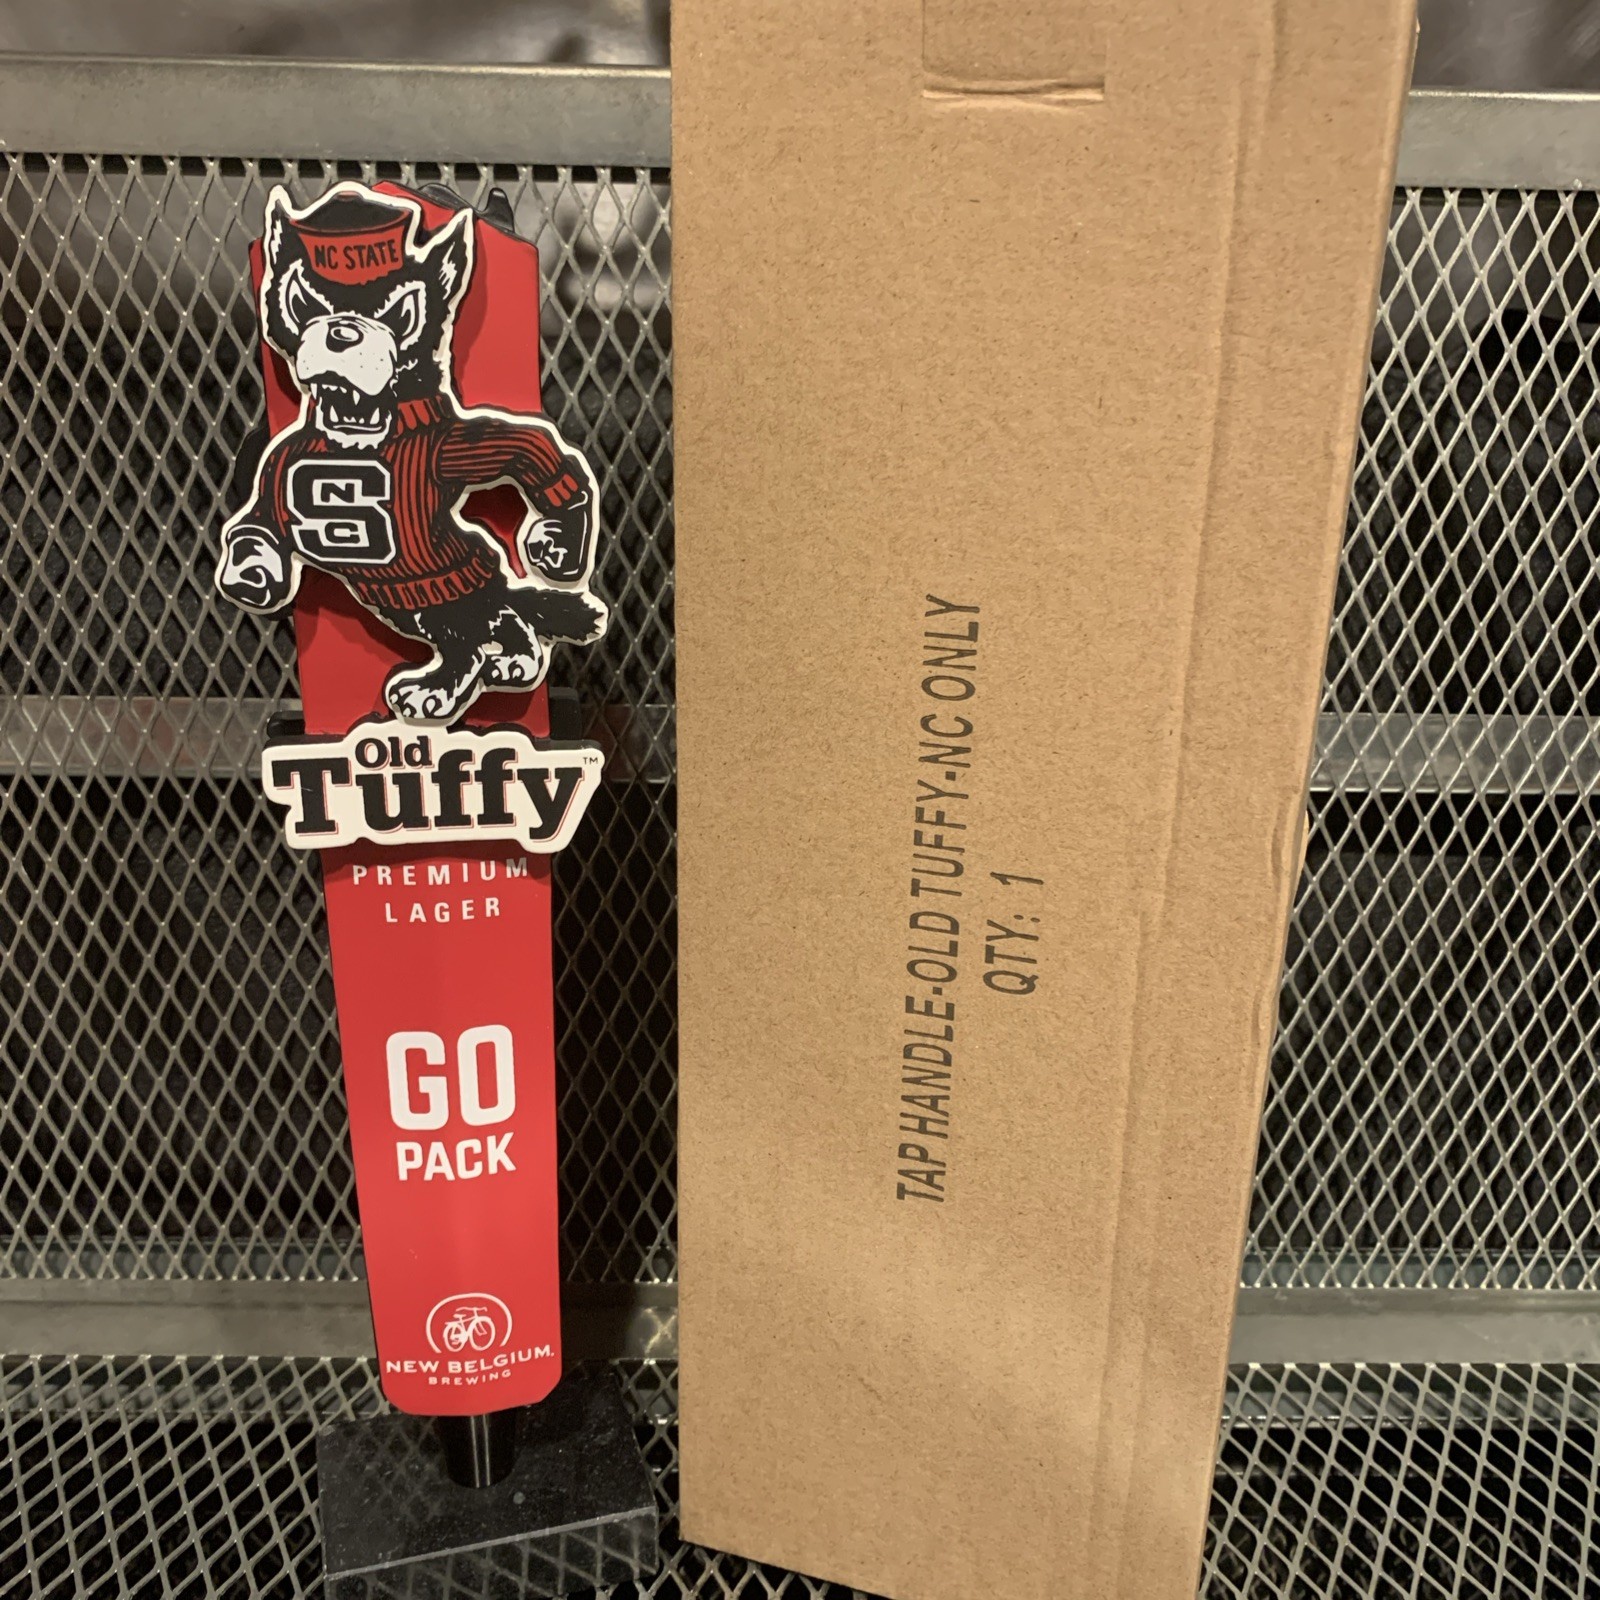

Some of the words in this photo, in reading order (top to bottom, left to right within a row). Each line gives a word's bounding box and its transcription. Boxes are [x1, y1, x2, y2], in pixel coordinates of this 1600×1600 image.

[314, 244, 339, 270] NC
[343, 239, 399, 270] STATE
[921, 593, 981, 701] ONLY
[355, 735, 432, 768] Old
[272, 748, 585, 842] Tuffy
[353, 857, 528, 885] PREMIUM
[989, 871, 1045, 886] 1
[385, 897, 500, 923] LAGER
[982, 913, 1041, 996] QTY:
[386, 1024, 516, 1130] GO
[396, 1132, 517, 1181] PACK
[896, 1143, 947, 1203] TAP
[386, 1360, 439, 1374] NEW
[428, 1369, 512, 1386] BREWING
